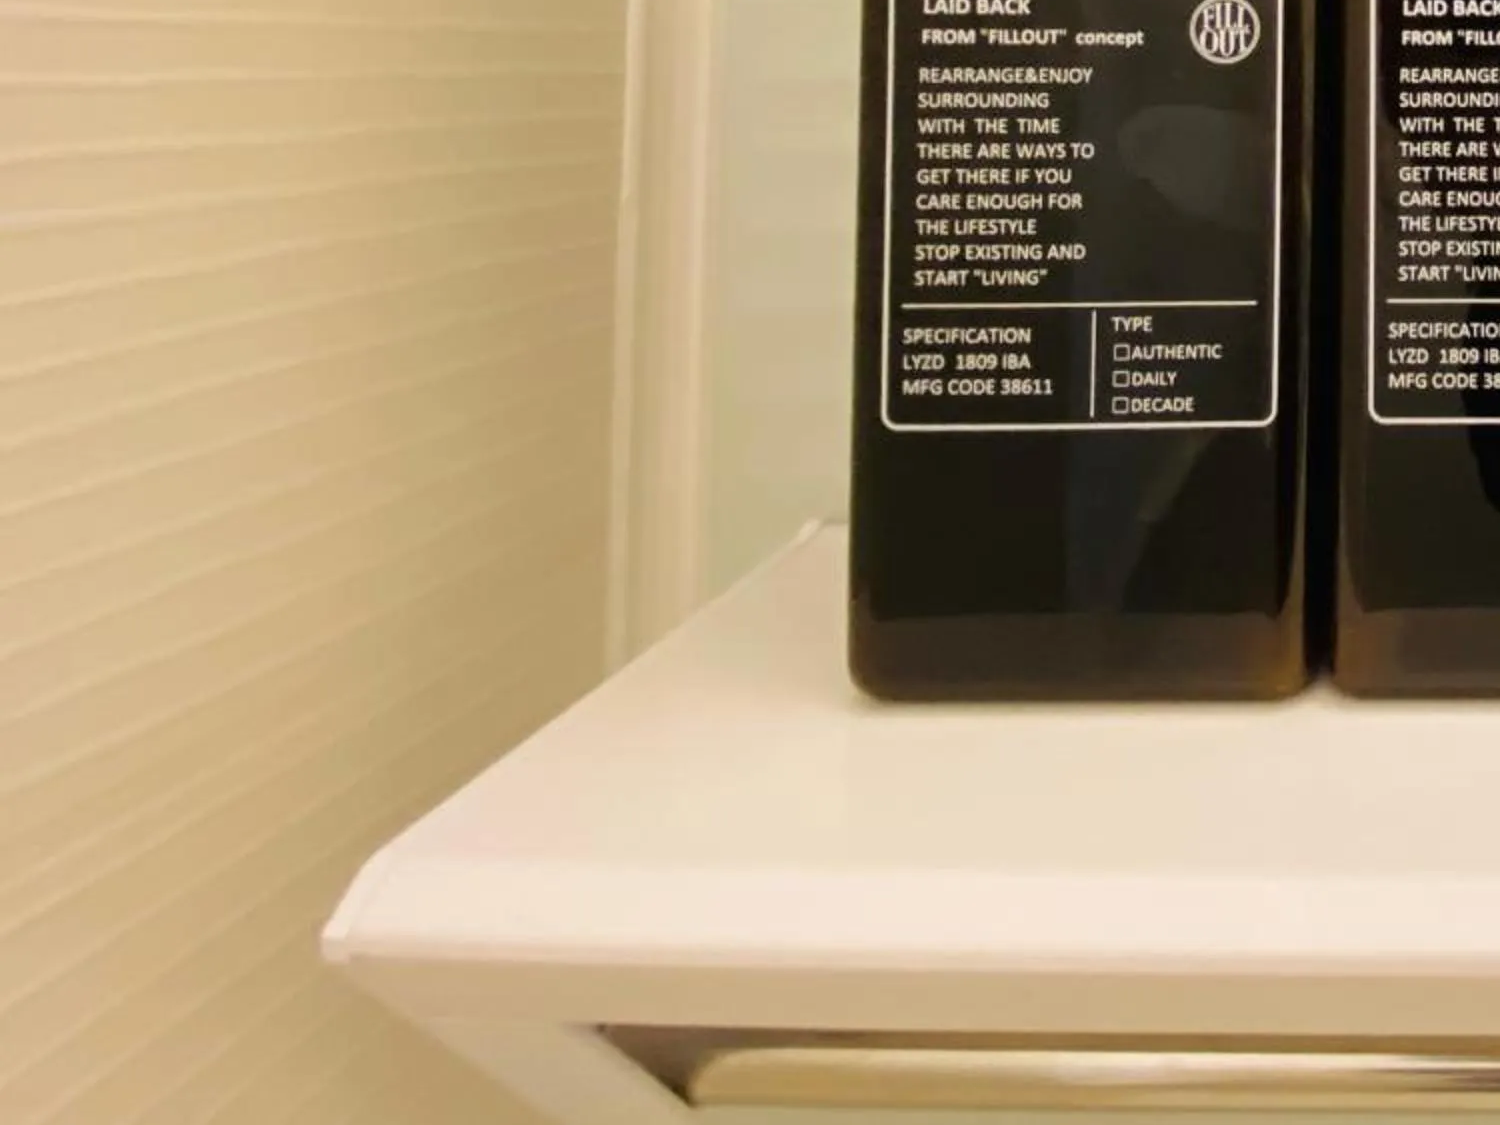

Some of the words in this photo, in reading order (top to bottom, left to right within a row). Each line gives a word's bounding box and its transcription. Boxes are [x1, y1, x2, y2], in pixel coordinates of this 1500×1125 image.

[1203, 3, 1250, 29] FILL
[921, 28, 977, 45] FROM
[979, 28, 1067, 46] "FILLOUT"
[1074, 30, 1145, 49] concept
[1200, 29, 1251, 58] OUT
[1401, 29, 1454, 46] FROM
[918, 66, 1093, 84] REARRANGE&ENJOY
[917, 91, 1050, 109] SURROUNDING
[917, 117, 966, 135] WITH
[973, 117, 1009, 135] THE
[1016, 117, 1061, 135] TIME
[1399, 116, 1445, 133] WITH
[1452, 116, 1486, 134] THE
[916, 142, 973, 160] THERE
[976, 142, 1011, 160] ARE
[1015, 142, 1067, 160] WAYS
[1069, 142, 1095, 160] TO
[1398, 140, 1452, 158] THERE
[1455, 140, 1489, 158] ARE
[915, 167, 952, 186] GET
[954, 167, 1011, 185] THERE
[1014, 167, 1031, 184] IF
[1033, 167, 1073, 185] YOU
[1398, 165, 1433, 183] GET
[1435, 165, 1489, 183] THERE
[915, 192, 962, 211] CARE
[965, 192, 1044, 211] ENOUGH
[1047, 192, 1083, 210] FOR
[1398, 190, 1442, 208] CARE
[914, 218, 950, 236] THE
[953, 218, 1037, 236] LIFESTYLE
[1397, 214, 1432, 233] THE
[914, 243, 961, 262] STOP
[964, 243, 1044, 261] EXISTING
[1046, 243, 1087, 260] AND
[1398, 239, 1443, 257] STOP
[913, 269, 971, 287] START
[972, 268, 1049, 287] "LIVING"
[1397, 264, 1451, 282] START
[1110, 315, 1153, 333] TYPE
[902, 326, 1032, 345] SPECIFICATION
[1131, 343, 1223, 361] AUTHENTIC
[1388, 347, 1430, 365] LYZD
[1439, 347, 1480, 365] 1809
[902, 353, 946, 371] LYZD
[955, 352, 999, 371] 1809
[1001, 352, 1032, 371] IBA
[902, 378, 944, 396] MFG
[947, 378, 996, 396] CODE
[999, 378, 1053, 396] 38611
[1131, 370, 1178, 388] DAILY
[1388, 372, 1428, 390] MFG
[1431, 371, 1479, 390] CODE
[1130, 396, 1194, 414] DECADE
